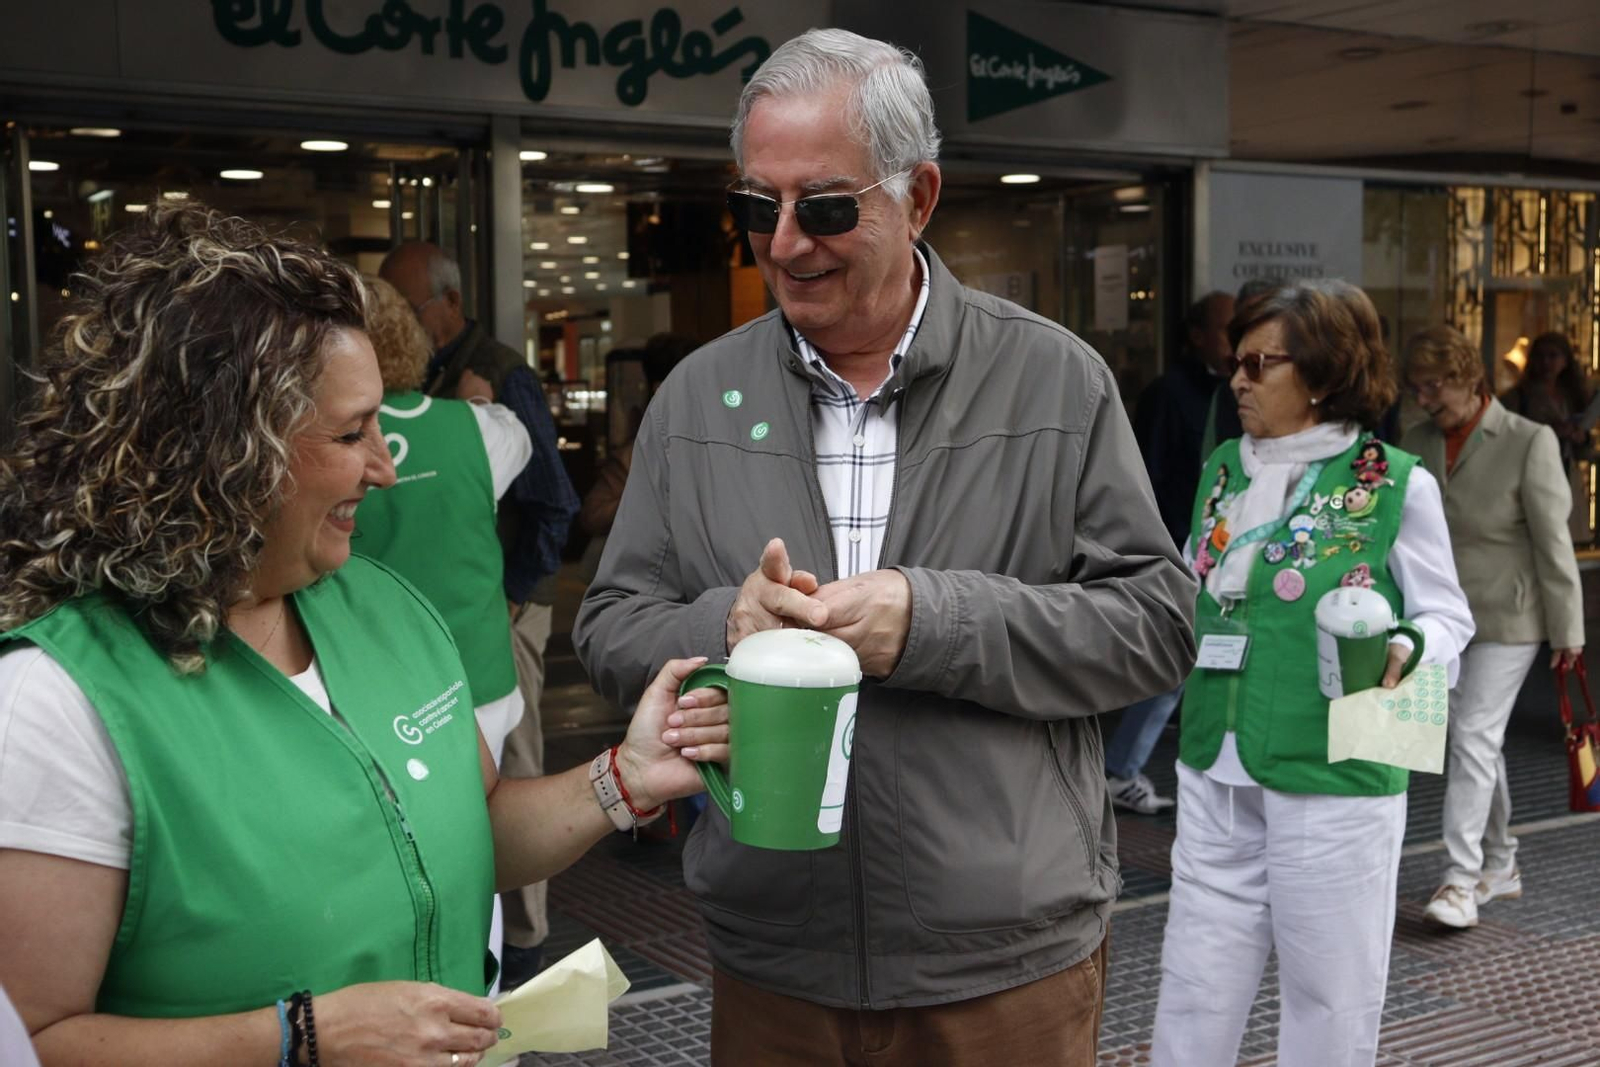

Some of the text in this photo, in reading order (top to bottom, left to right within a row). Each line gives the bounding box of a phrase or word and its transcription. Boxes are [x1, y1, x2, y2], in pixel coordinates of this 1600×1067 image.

[306, 0, 508, 64] Corte
[519, 0, 770, 105] Inglés
[1238, 241, 1318, 256] EXCLUSIVE
